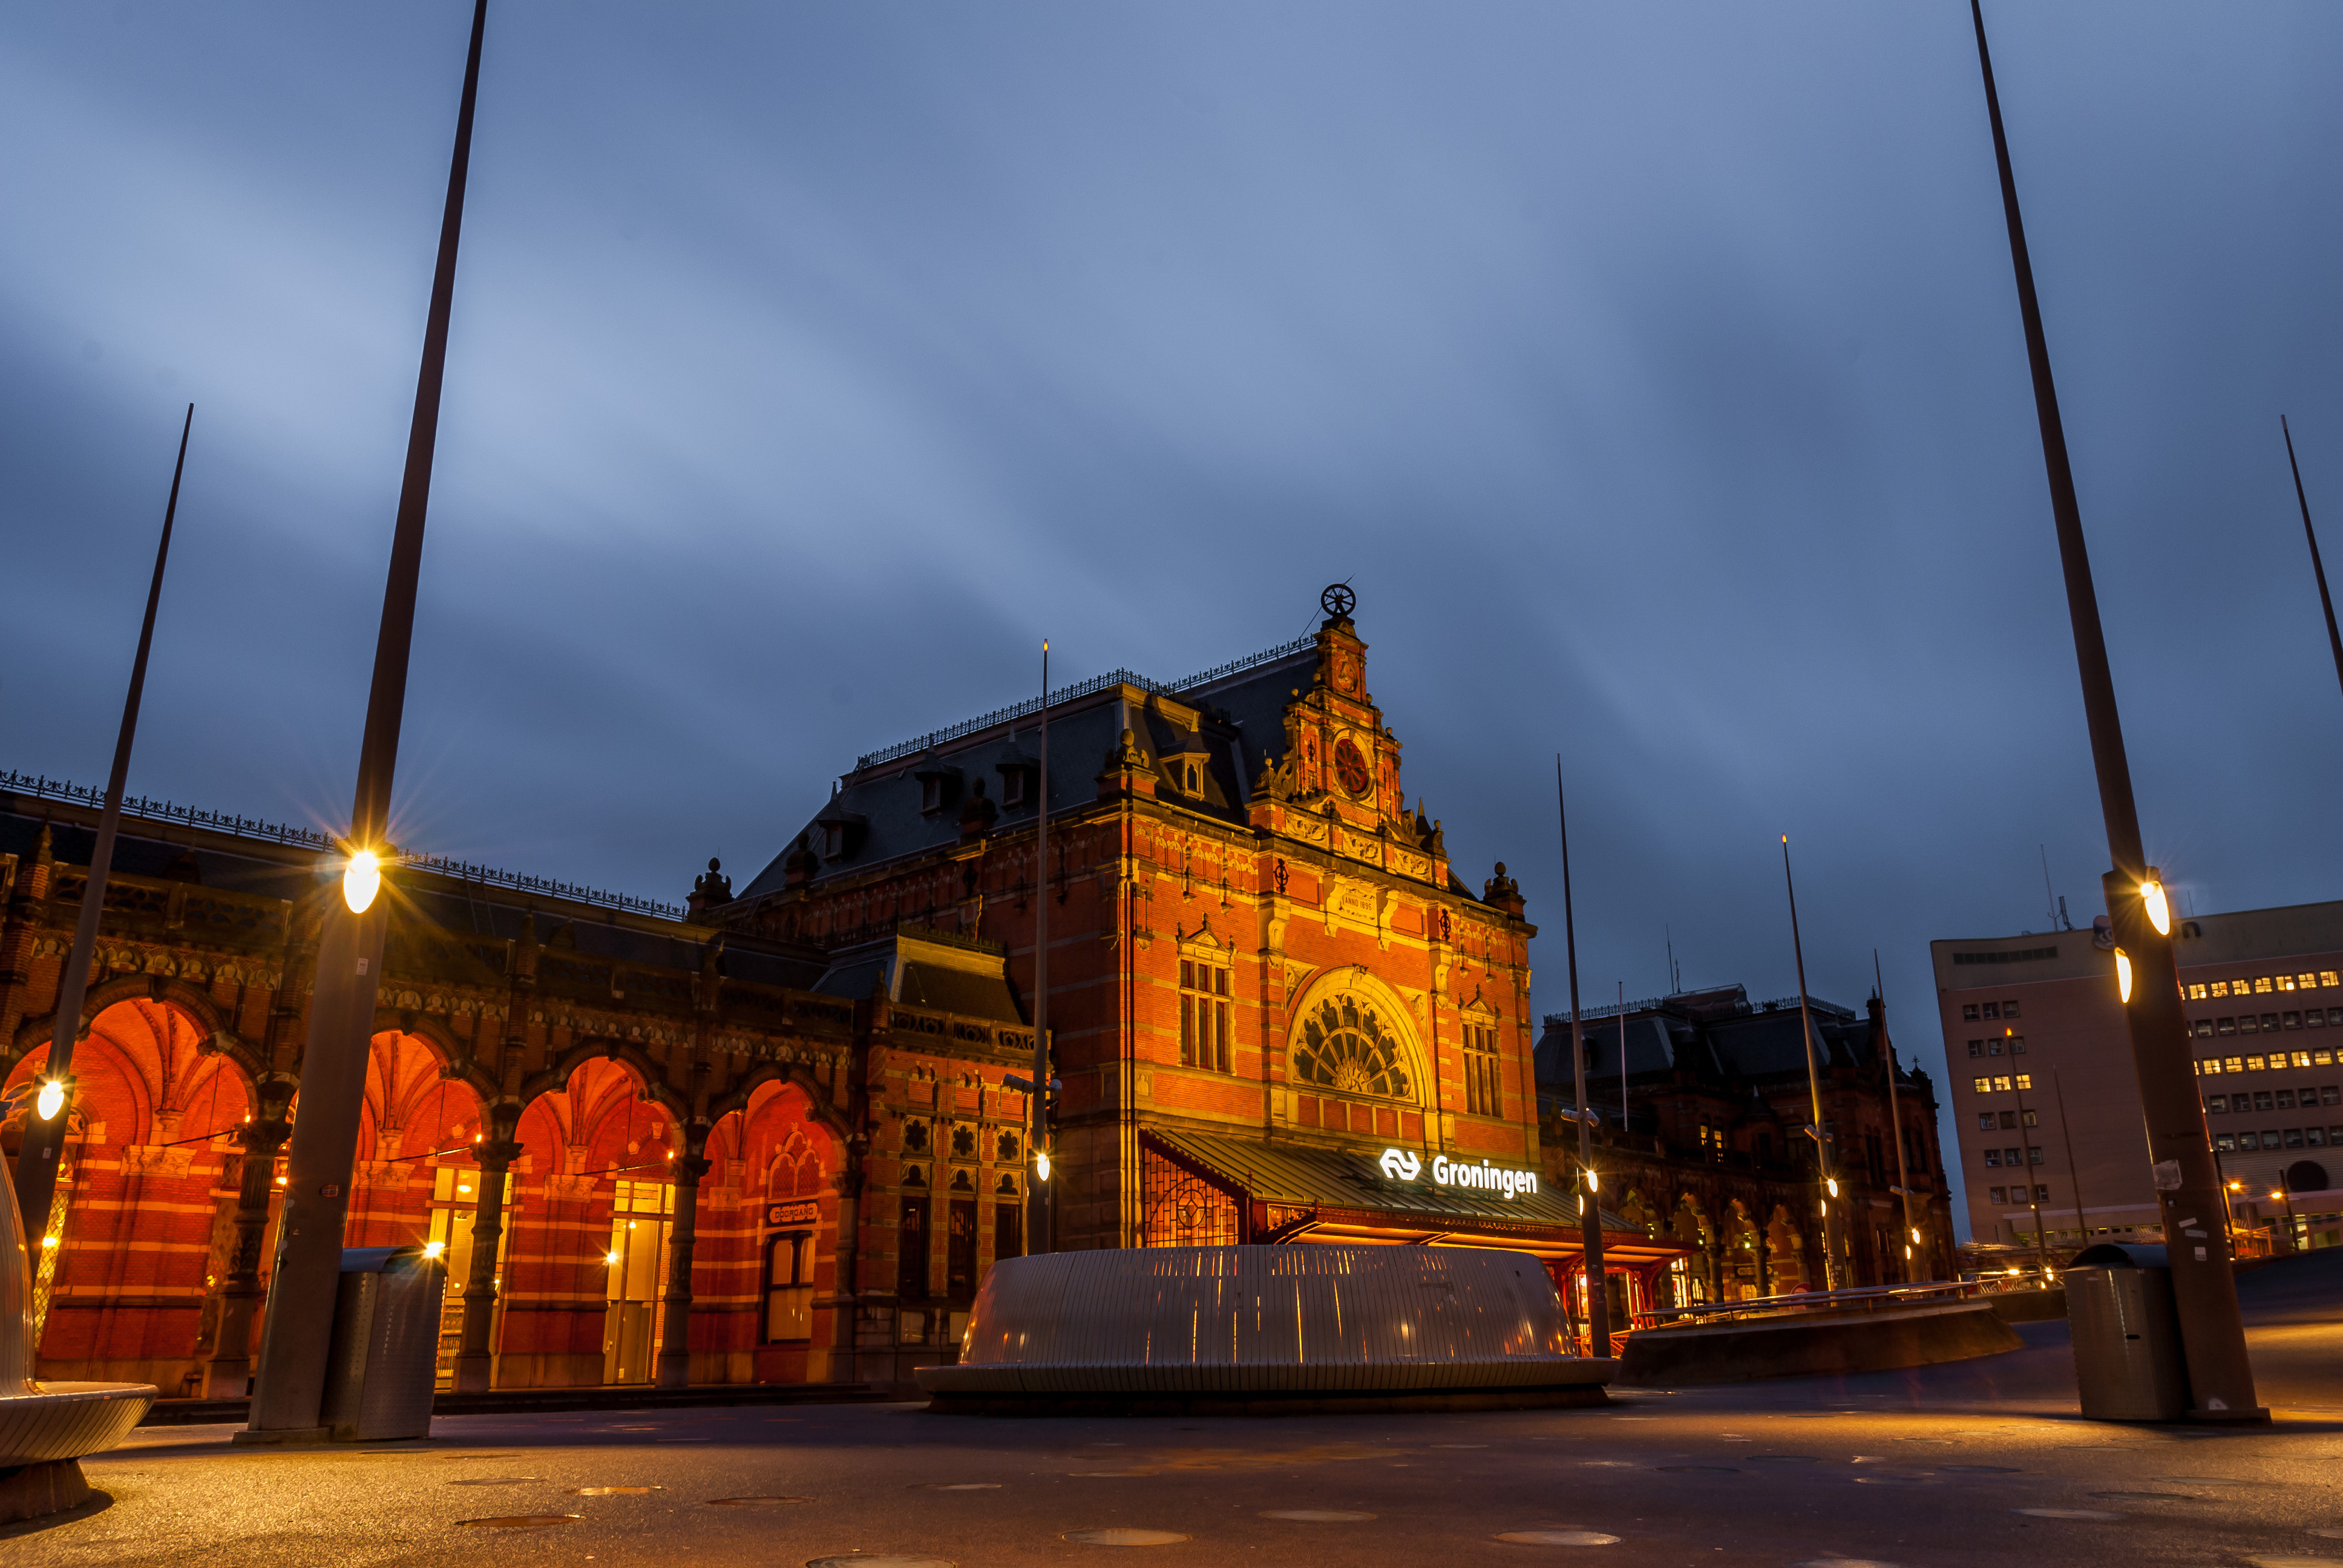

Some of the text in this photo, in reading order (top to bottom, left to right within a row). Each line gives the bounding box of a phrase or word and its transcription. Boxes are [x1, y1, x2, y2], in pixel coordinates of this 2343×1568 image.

[1345, 896, 1372, 910] ANNO 1895
[1433, 1155, 1538, 1200] Groningen
[775, 1207, 813, 1219] DOORGANG
